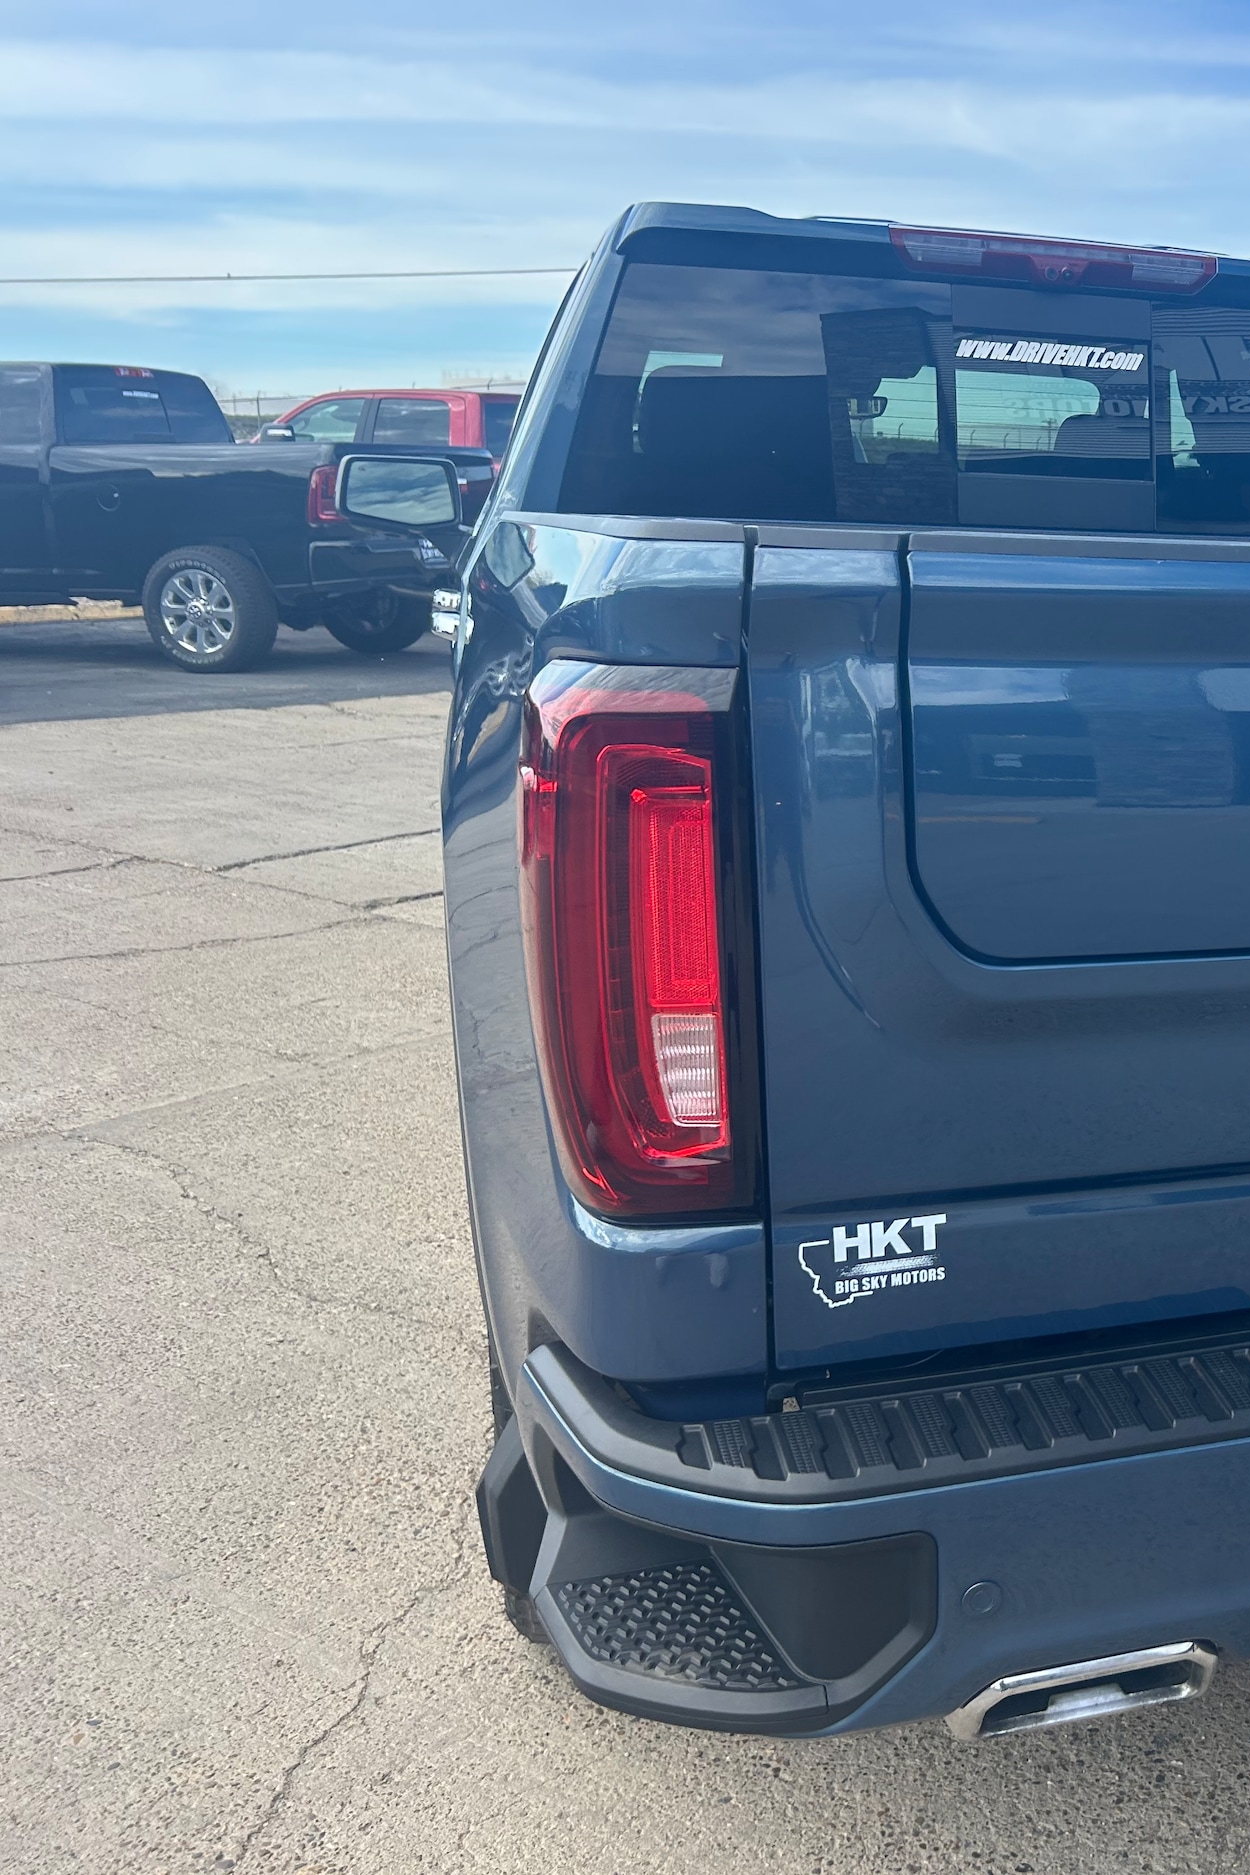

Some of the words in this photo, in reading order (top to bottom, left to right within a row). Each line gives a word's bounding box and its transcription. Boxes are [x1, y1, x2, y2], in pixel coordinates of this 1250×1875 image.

[956, 339, 1144, 371] www.DRIVEHKT.com
[832, 1213, 946, 1262] HKT
[835, 1279, 858, 1294] BIG
[861, 1274, 889, 1291] SKY
[891, 1267, 945, 1286] MOTORS
